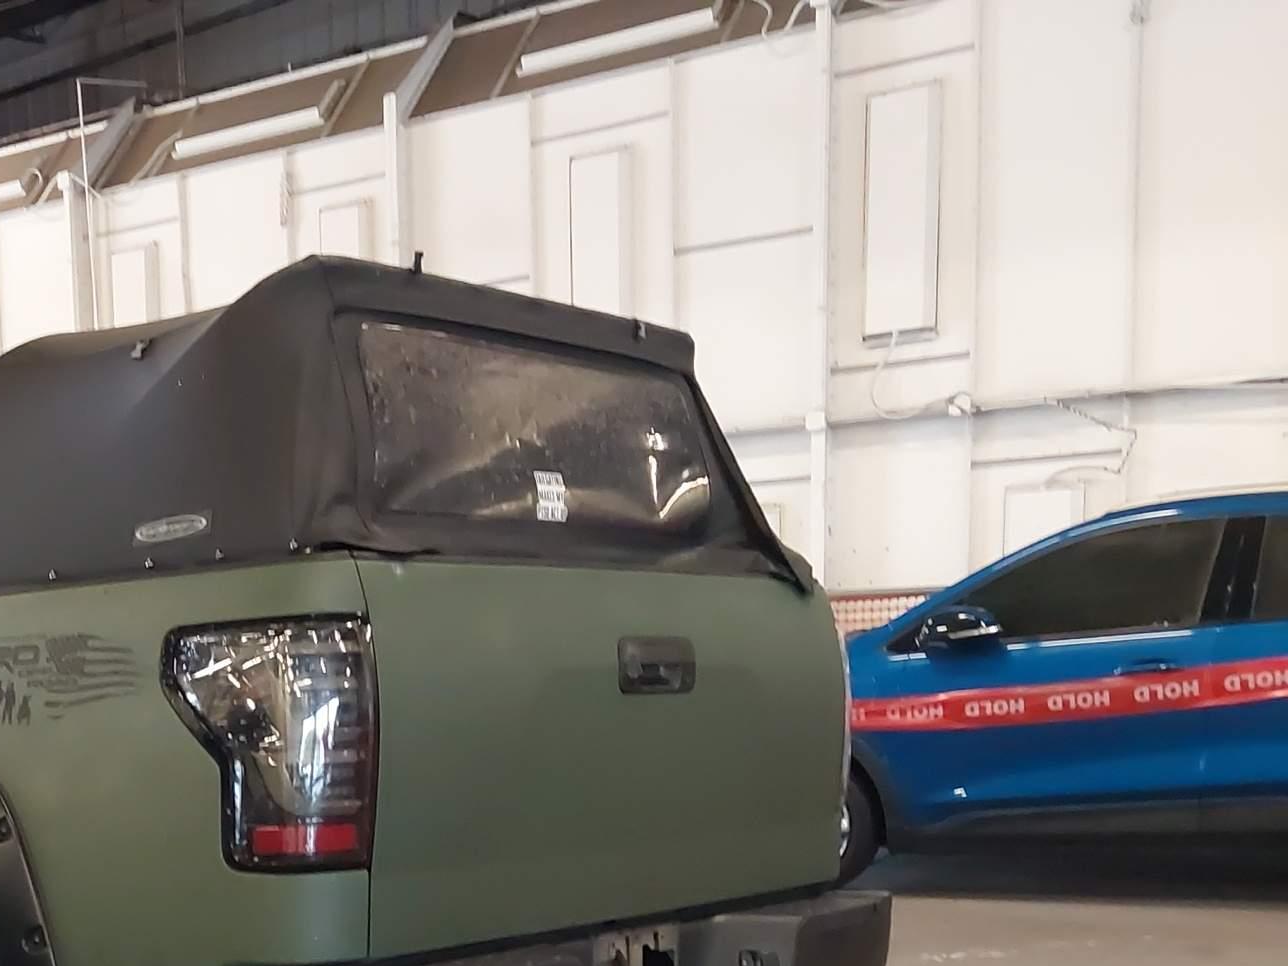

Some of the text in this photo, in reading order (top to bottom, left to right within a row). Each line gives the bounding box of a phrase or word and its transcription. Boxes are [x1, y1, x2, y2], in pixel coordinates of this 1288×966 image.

[965, 697, 1025, 718] HOLD
[1047, 689, 1110, 711] HOLD
[1134, 679, 1200, 703] HOLD
